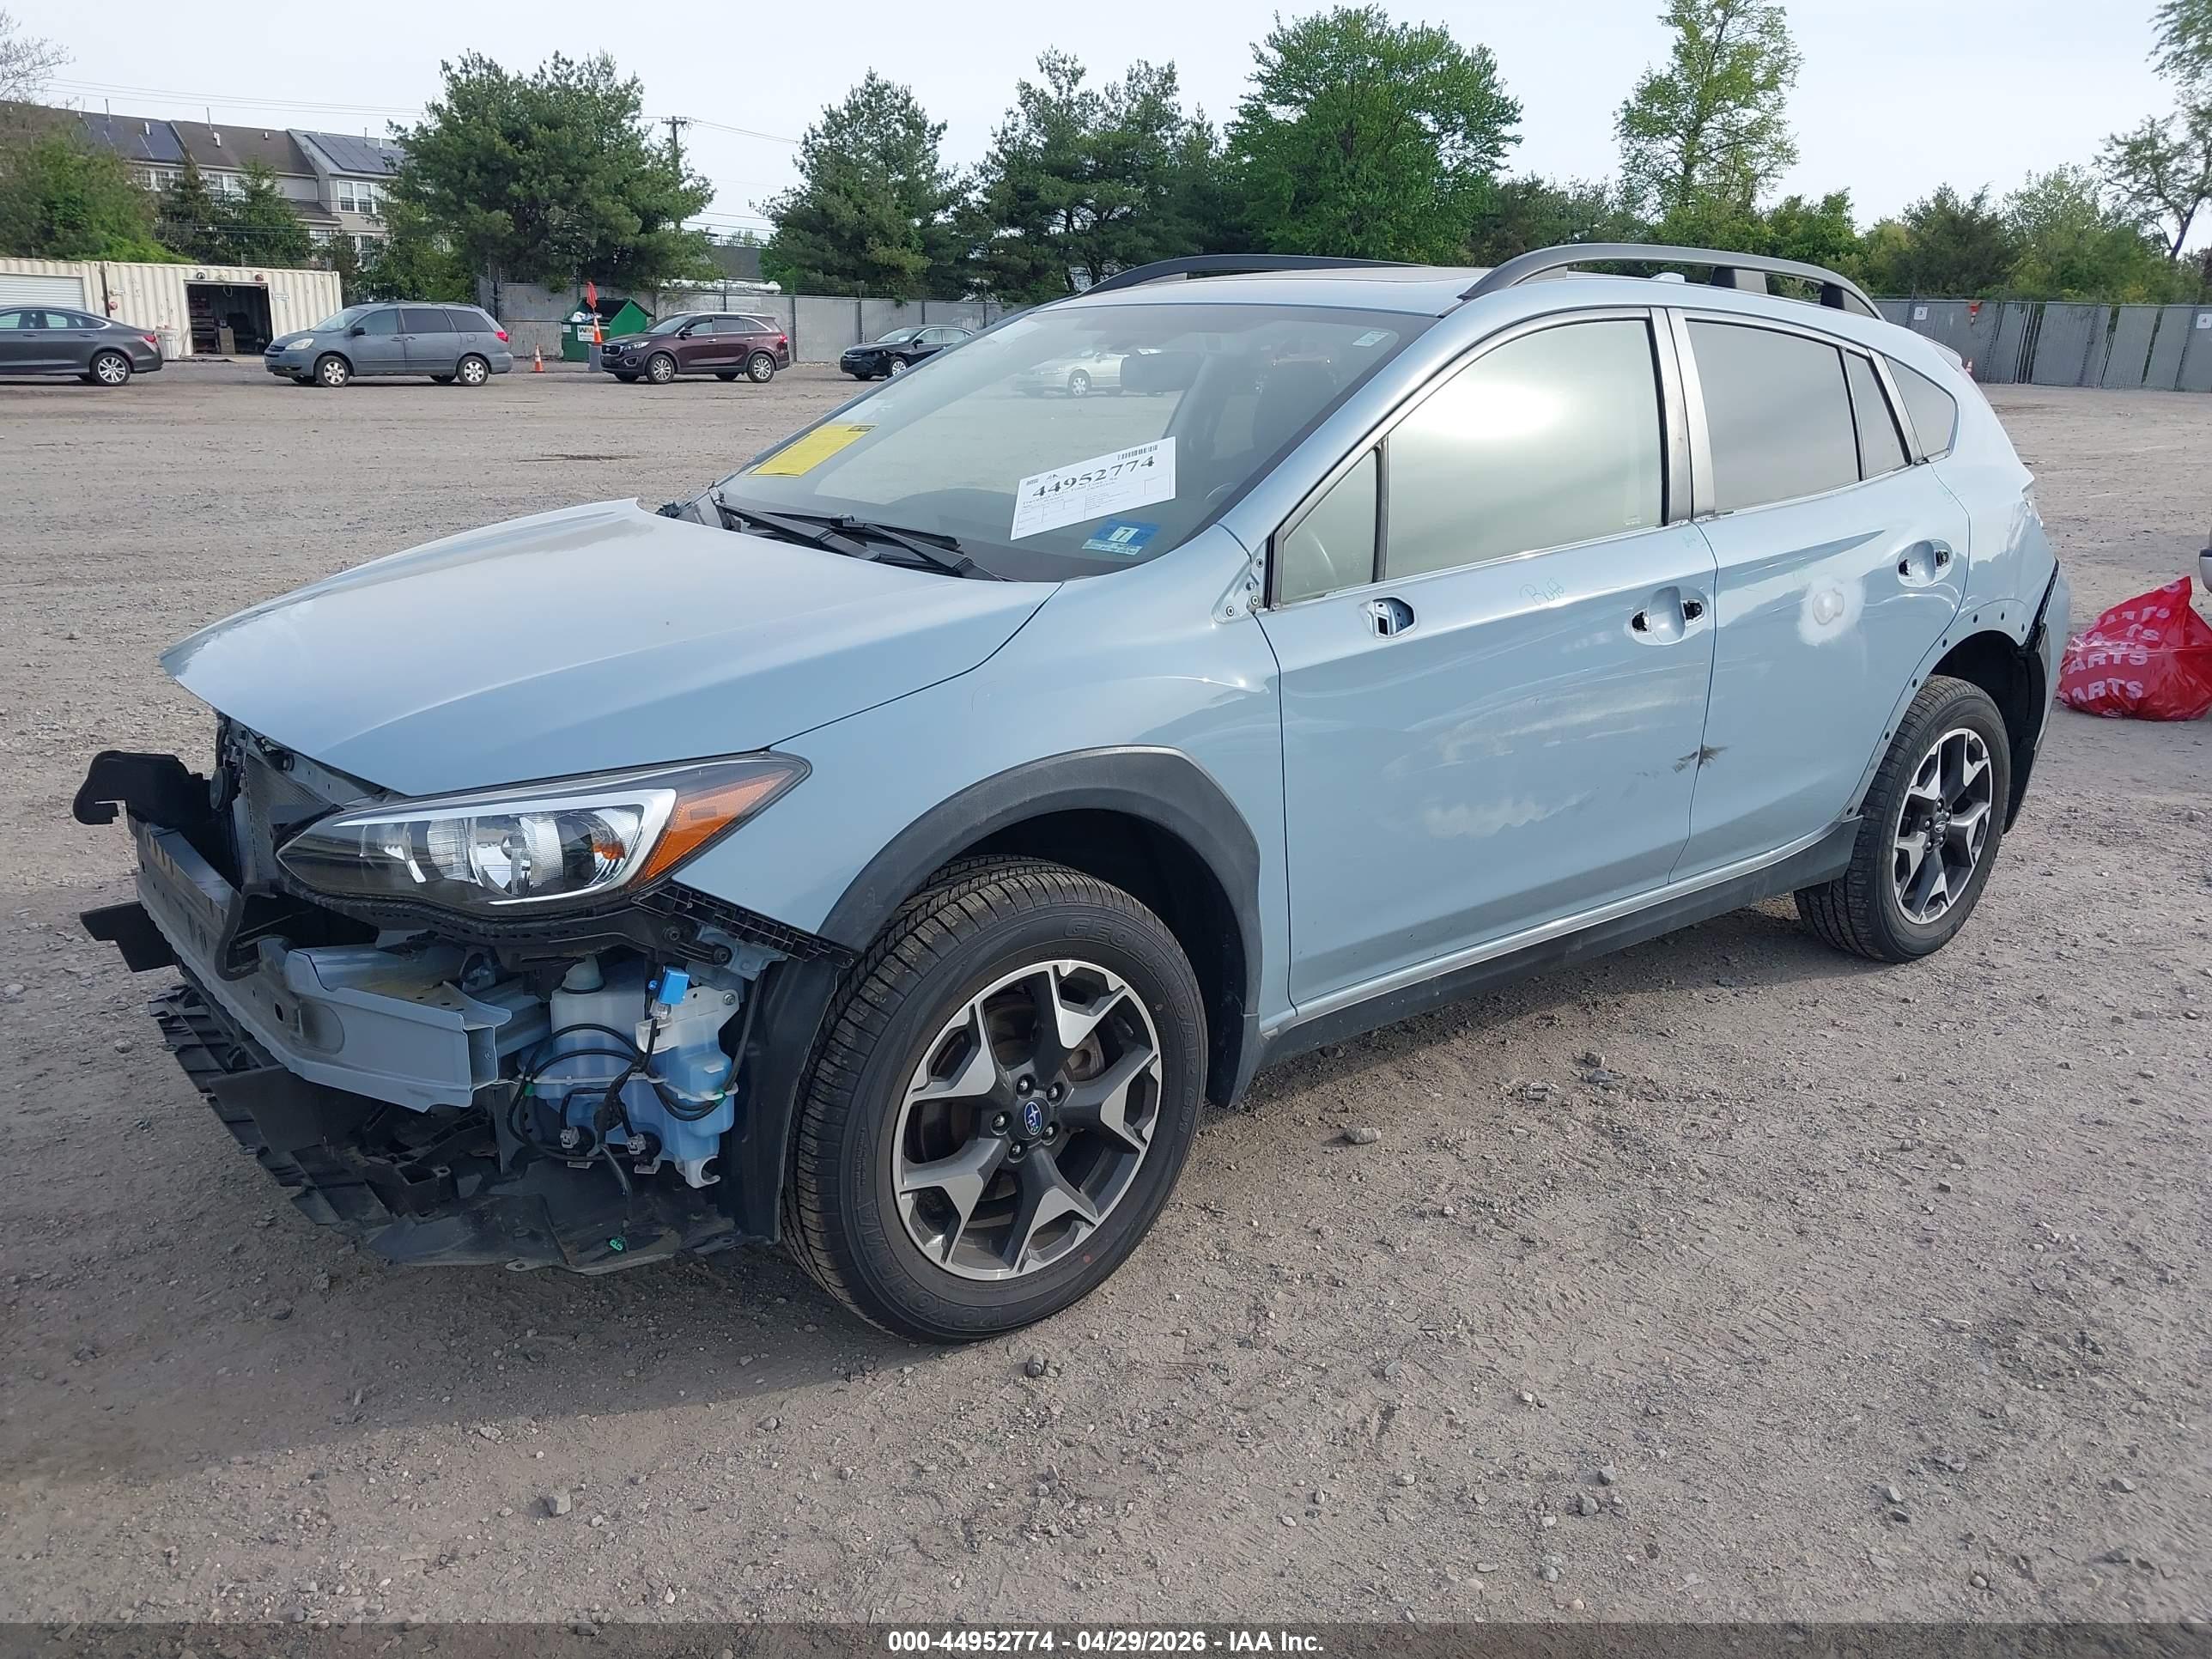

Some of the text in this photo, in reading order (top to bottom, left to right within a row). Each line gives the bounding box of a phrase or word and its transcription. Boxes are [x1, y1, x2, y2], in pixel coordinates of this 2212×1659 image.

[1032, 455, 1155, 497] 44952774
[1116, 528, 1131, 541] 7
[1064, 916, 1199, 1074] GEOLANDAR
[856, 1199, 1002, 1328] YOKOHAMA
